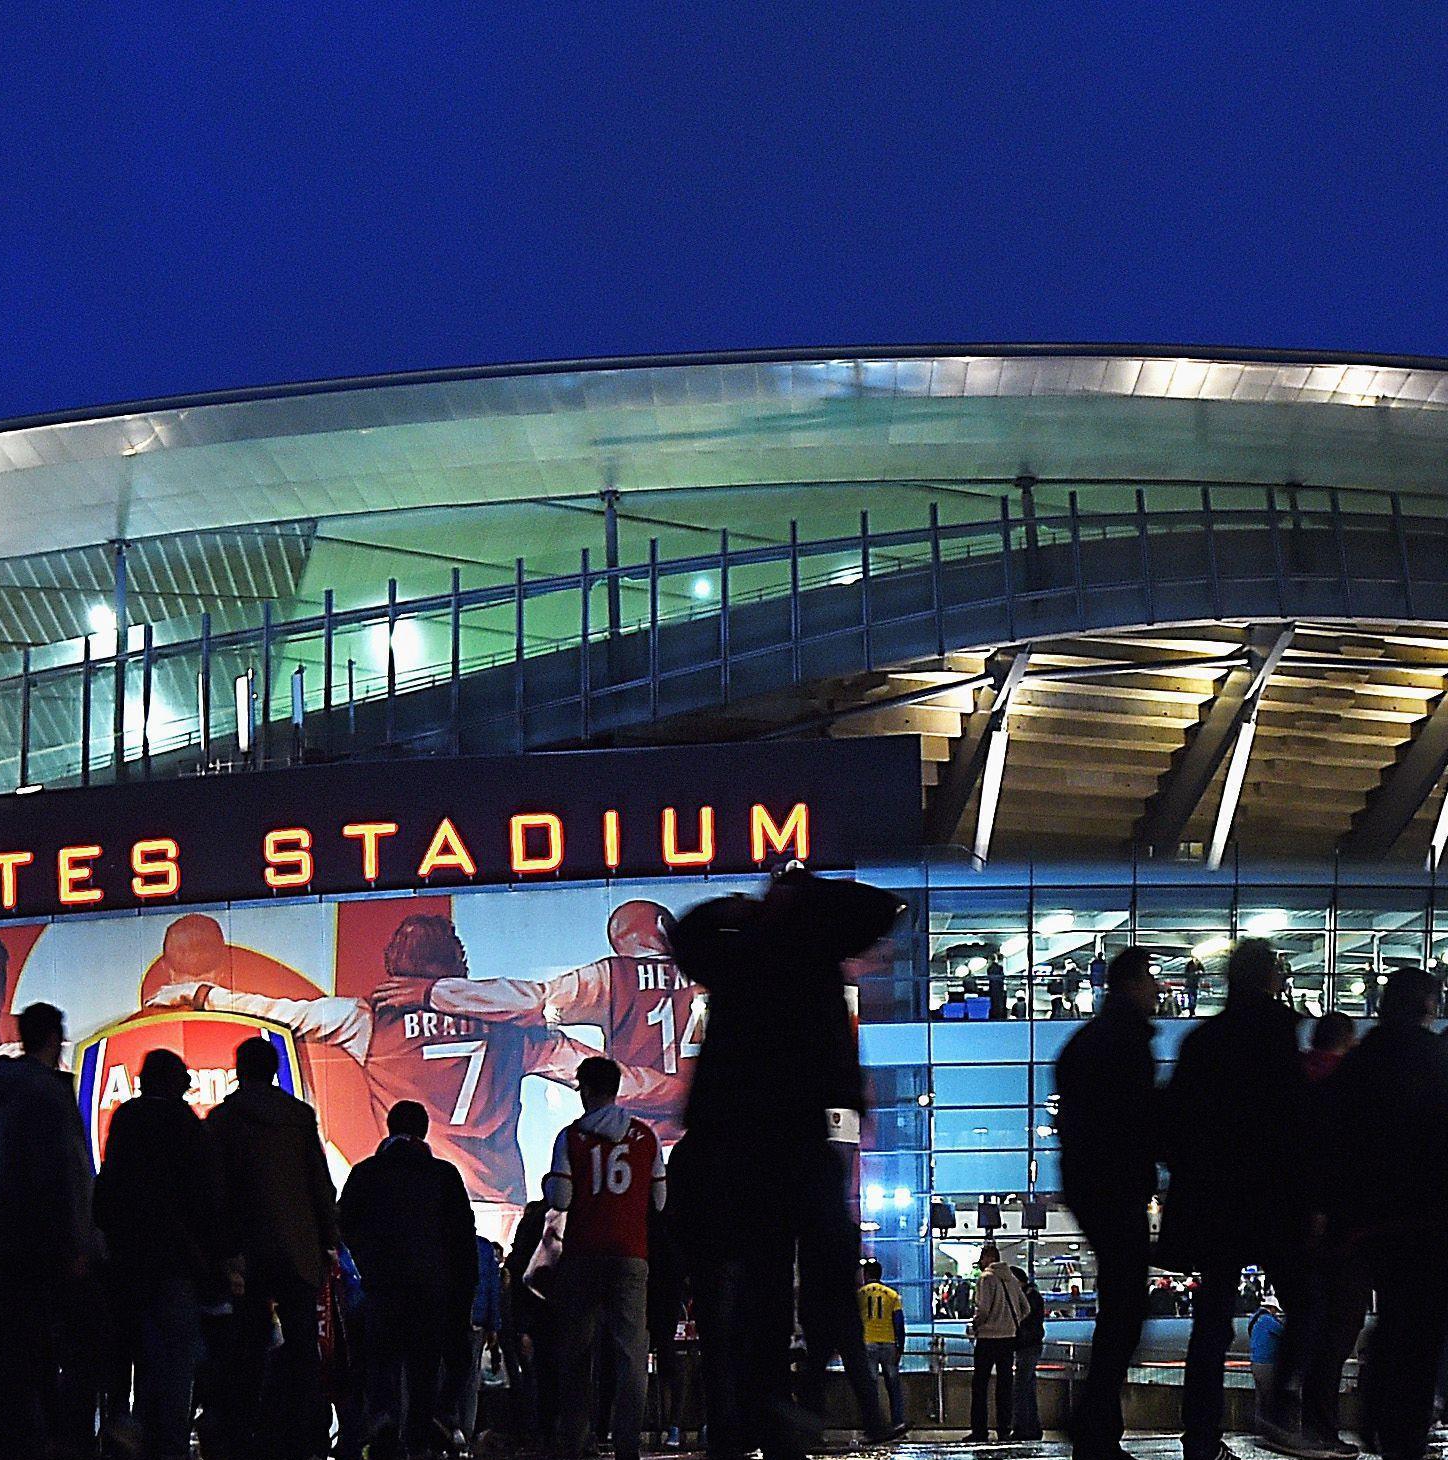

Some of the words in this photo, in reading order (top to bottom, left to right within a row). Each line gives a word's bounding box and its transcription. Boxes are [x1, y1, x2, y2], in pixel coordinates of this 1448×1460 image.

[263, 803, 809, 889] STADIUM
[637, 963, 697, 991] HEN
[404, 1012, 490, 1039] BRAD
[423, 1041, 488, 1125] 7
[590, 1143, 632, 1195] 16
[867, 1295, 883, 1320] 11
